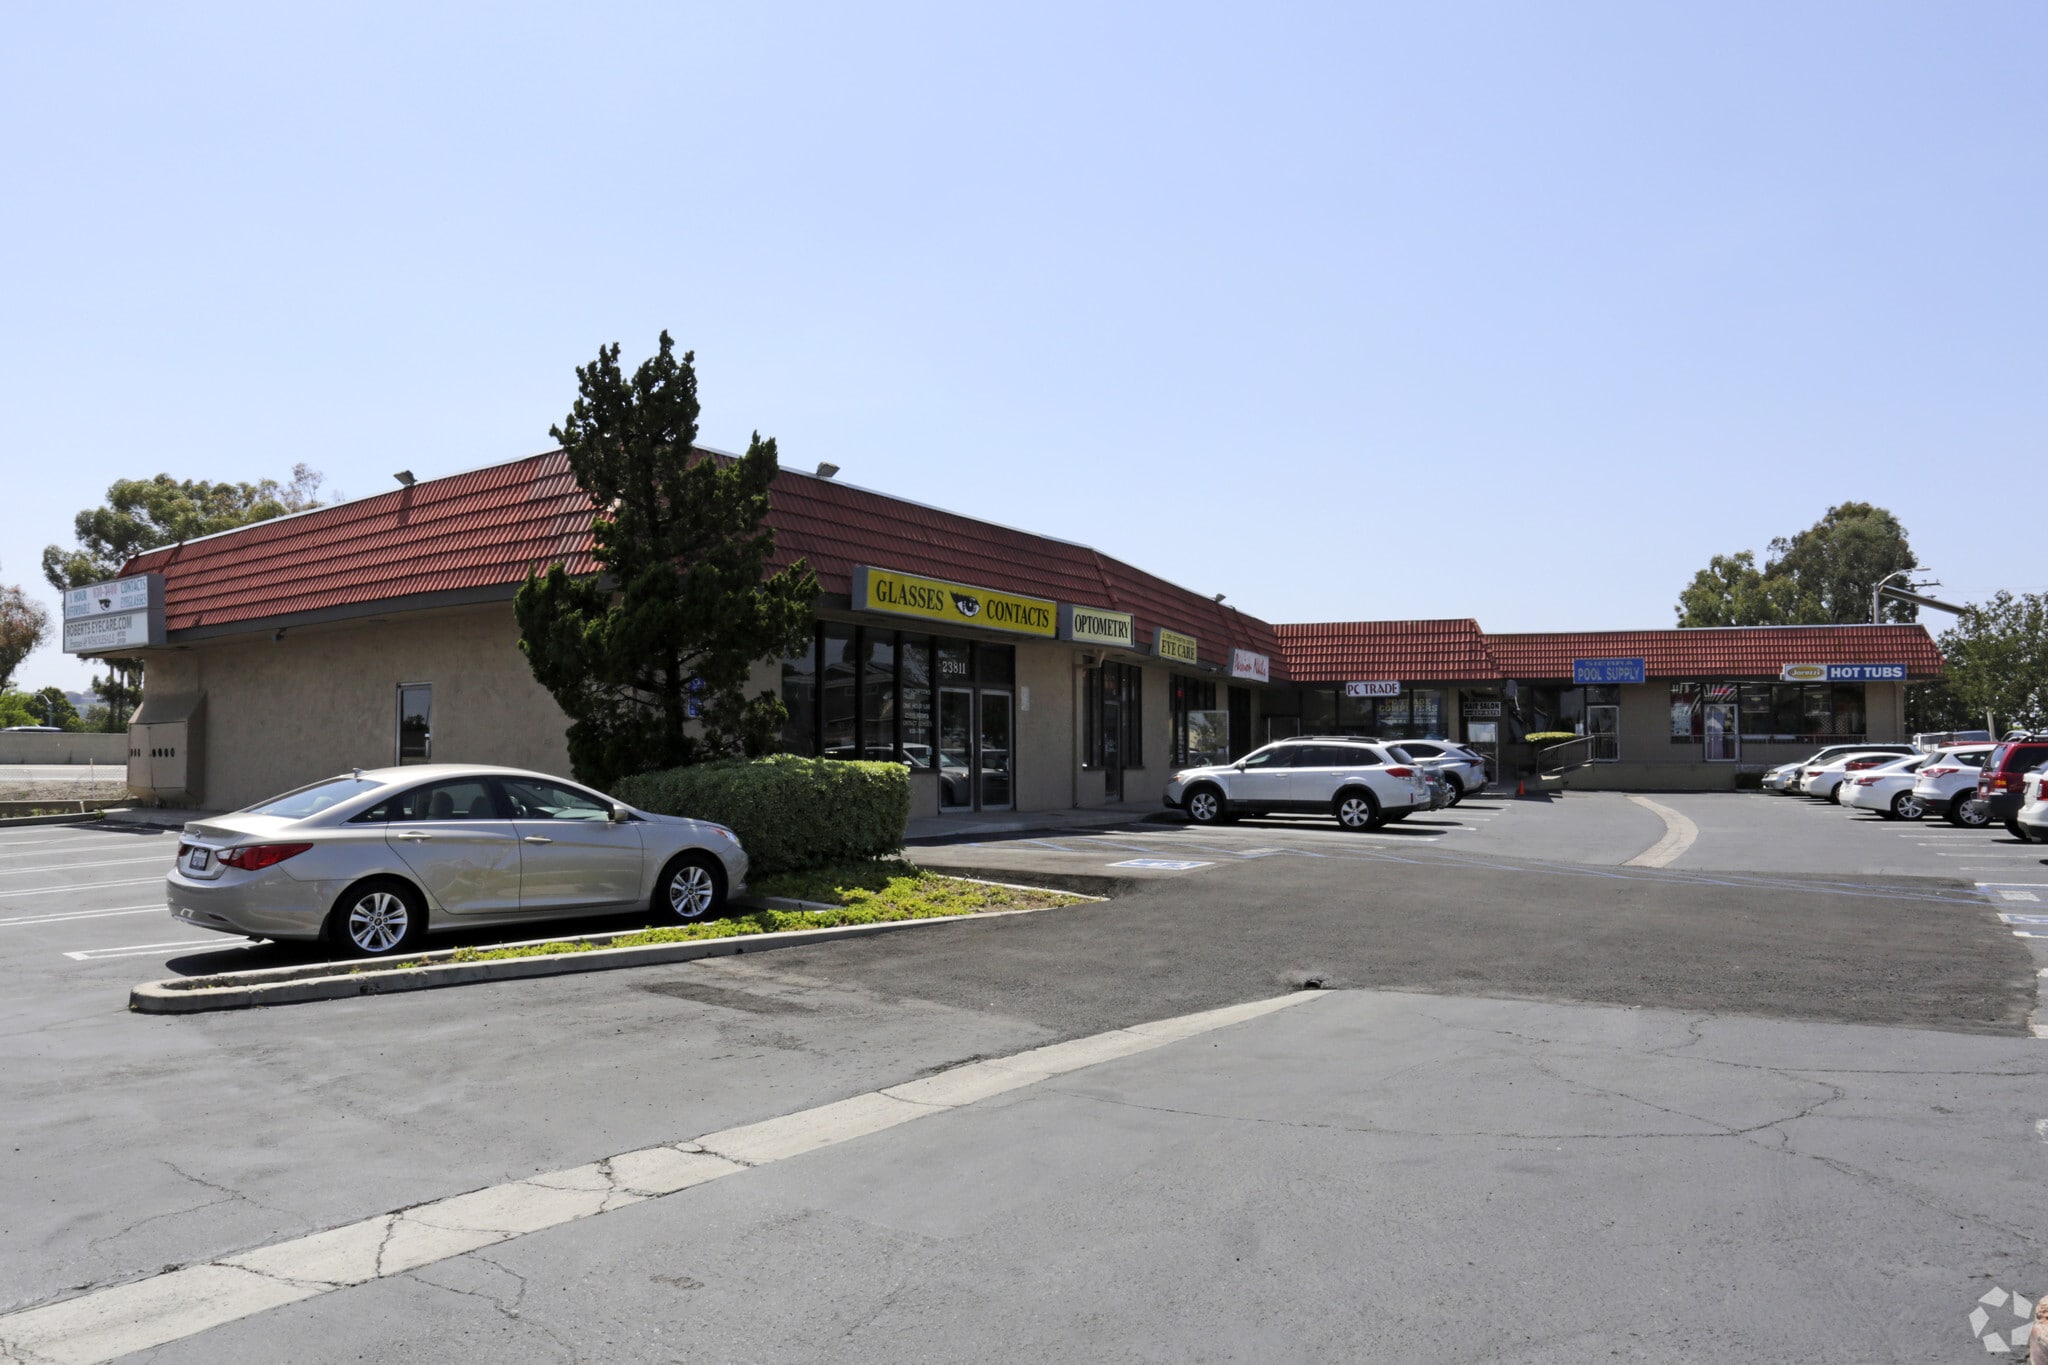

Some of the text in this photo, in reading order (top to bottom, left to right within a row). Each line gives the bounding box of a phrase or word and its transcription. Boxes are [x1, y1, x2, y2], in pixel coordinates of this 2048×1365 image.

[876, 579, 1049, 628] GLASSES CONTACTS
[1074, 614, 1130, 639] OPTOMETRY
[1161, 639, 1177, 656] EYE
[1177, 644, 1195, 660] CARE
[942, 661, 966, 674] 23811
[1578, 667, 1640, 681] POOL SUPPLY
[1830, 667, 1861, 678] HOT
[1864, 666, 1903, 678] TUBS
[1347, 682, 1398, 696] PC TRADE
[1379, 704, 1438, 712] COMPTERS
